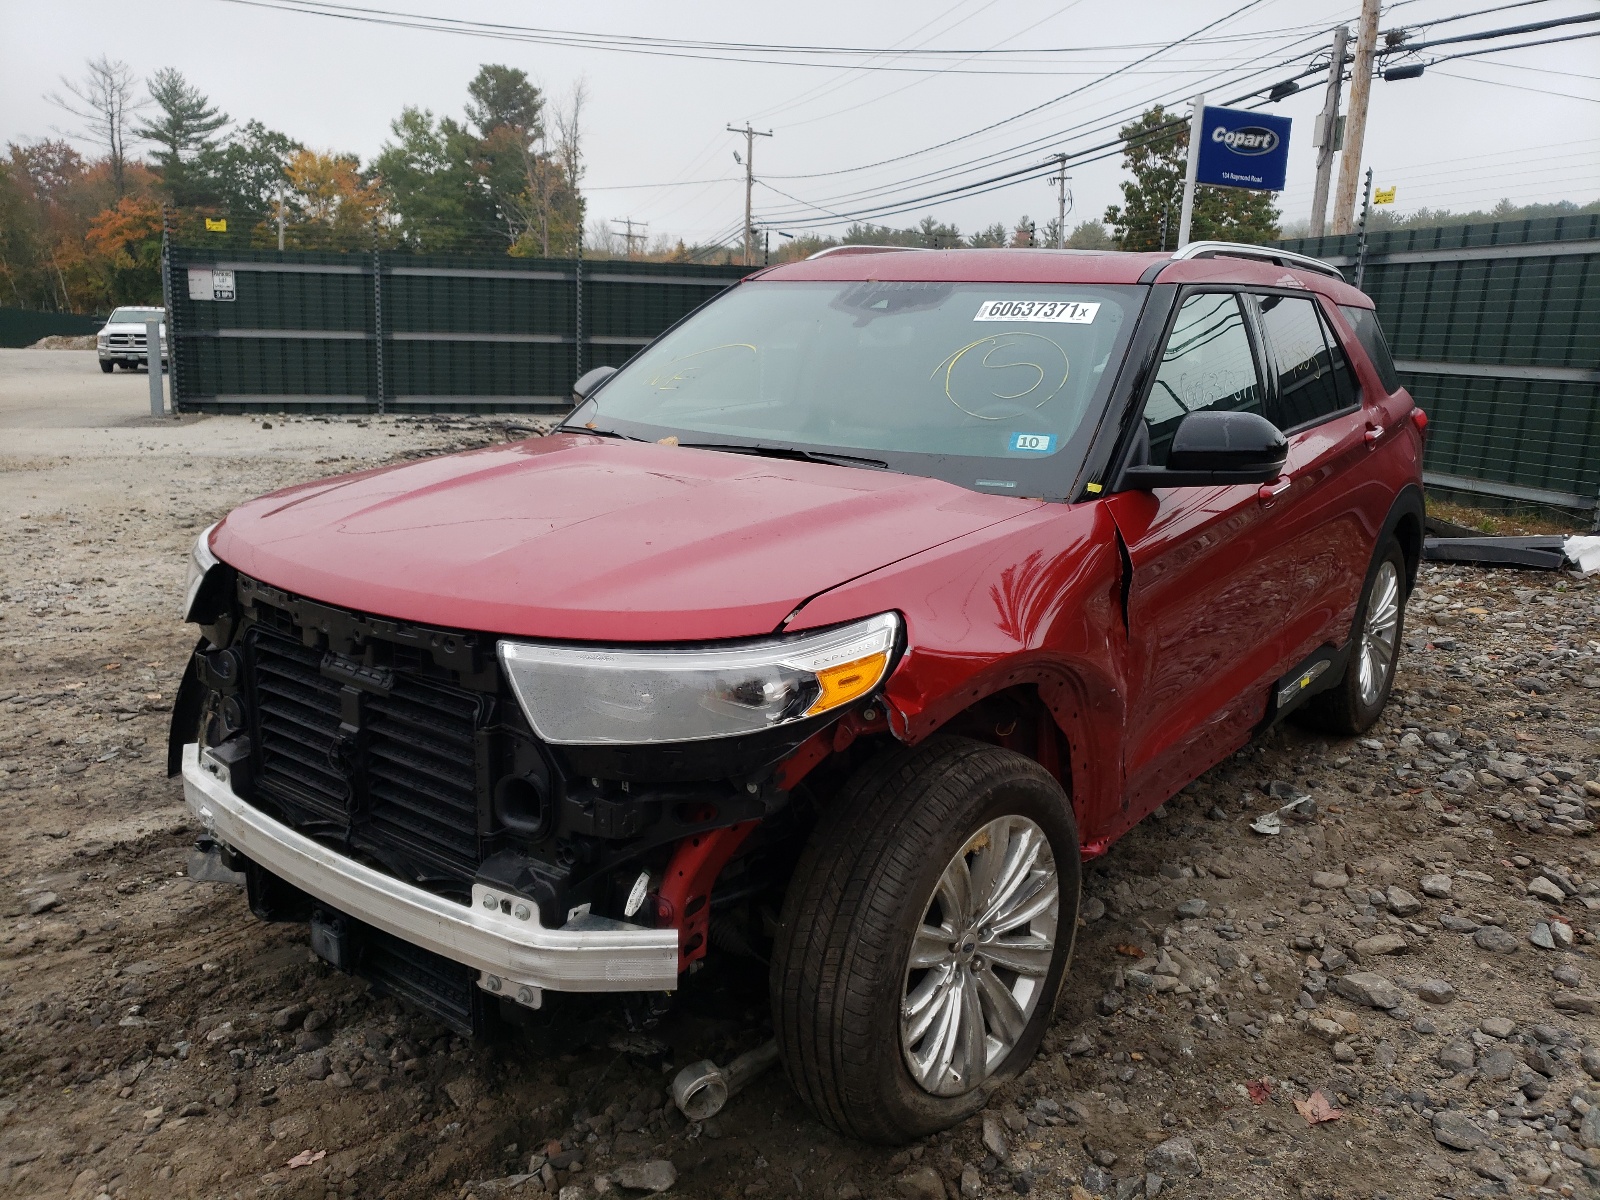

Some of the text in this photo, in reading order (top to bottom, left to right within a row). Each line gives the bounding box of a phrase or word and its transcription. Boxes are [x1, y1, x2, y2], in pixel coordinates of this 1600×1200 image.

[1212, 126, 1272, 149] Copart
[1230, 172, 1250, 182] Raymond
[1251, 175, 1263, 183] Road
[1018, 436, 1040, 449] 10
[812, 639, 881, 666] EXPLORER
